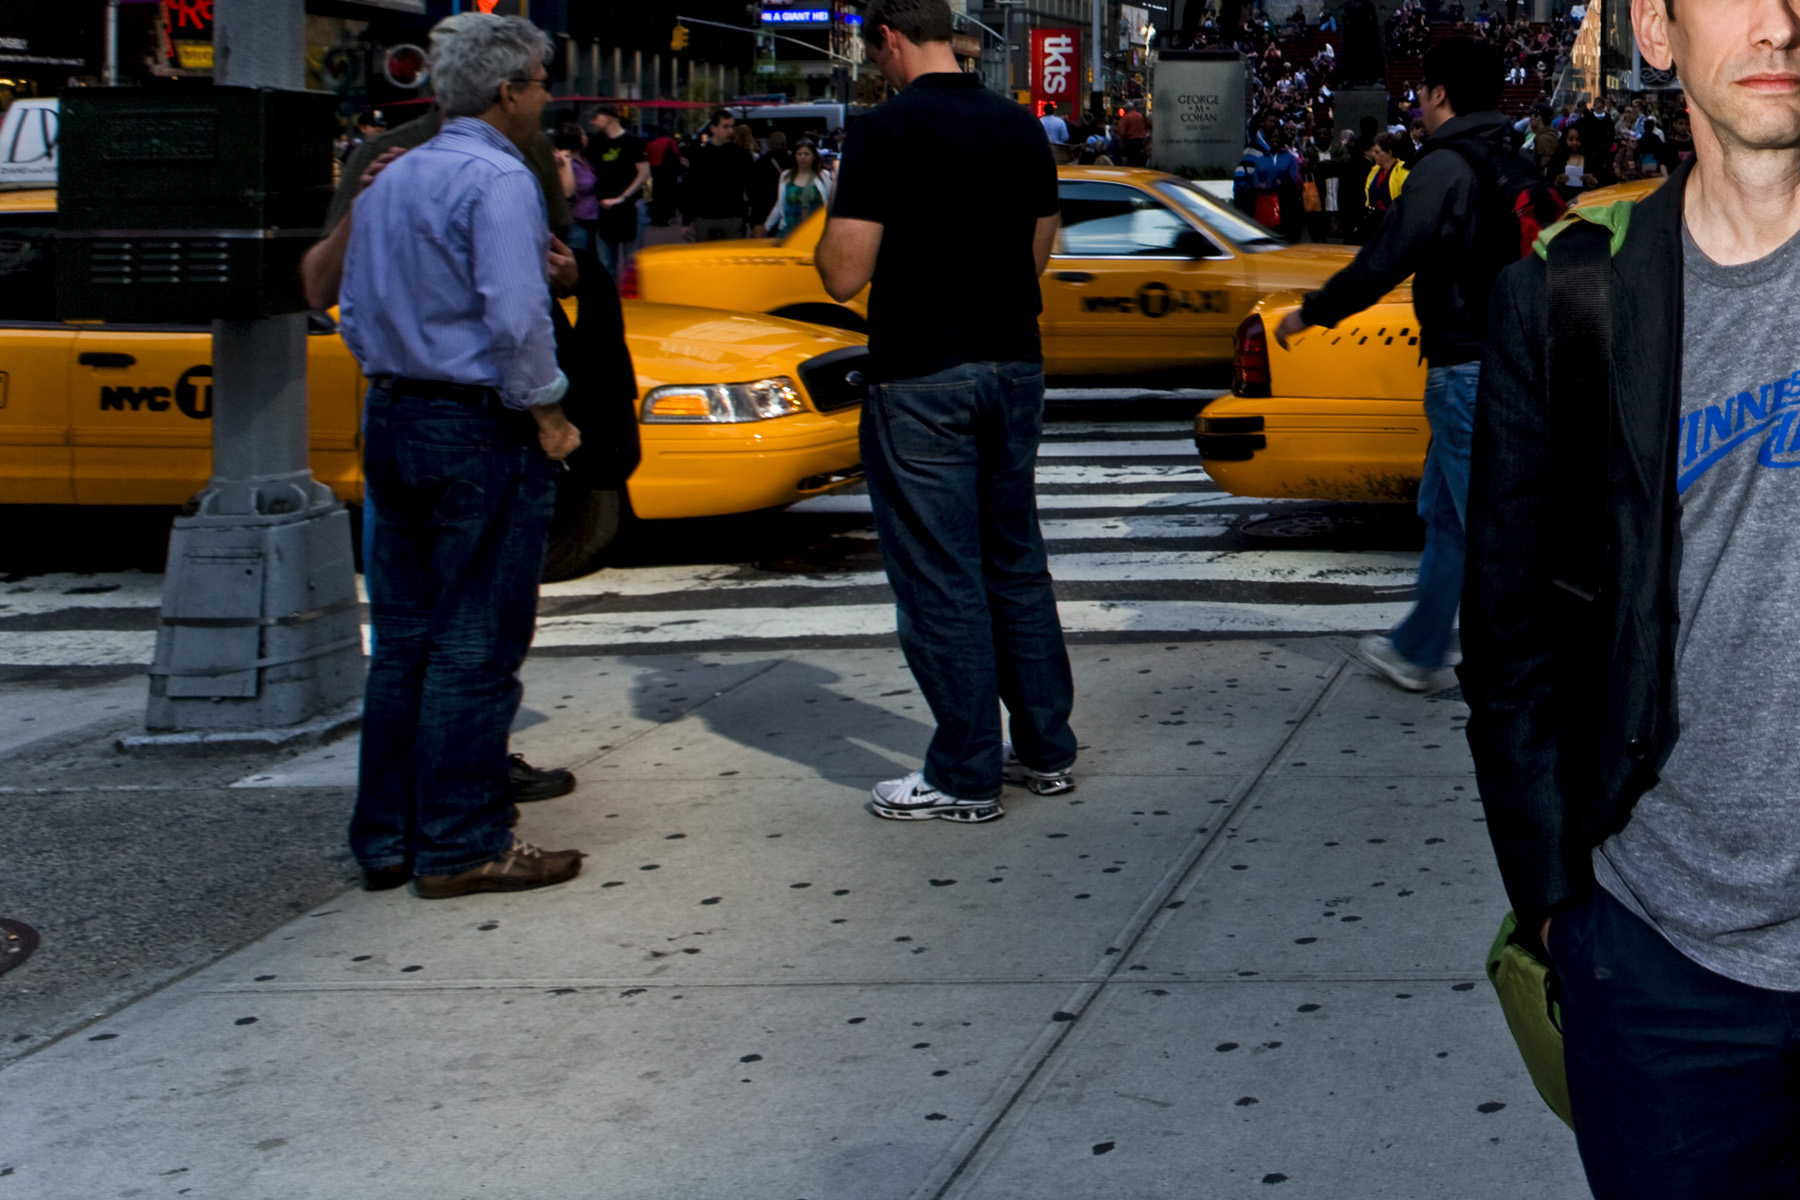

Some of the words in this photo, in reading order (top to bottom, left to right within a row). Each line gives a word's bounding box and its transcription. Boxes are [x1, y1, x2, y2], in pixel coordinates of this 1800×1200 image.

[773, 11, 781, 22] A
[782, 11, 810, 22] GIANT
[1042, 33, 1075, 96] tkts
[1177, 94, 1220, 106] GEORGE
[1179, 112, 1218, 123] COHAN
[100, 385, 171, 413] NYC
